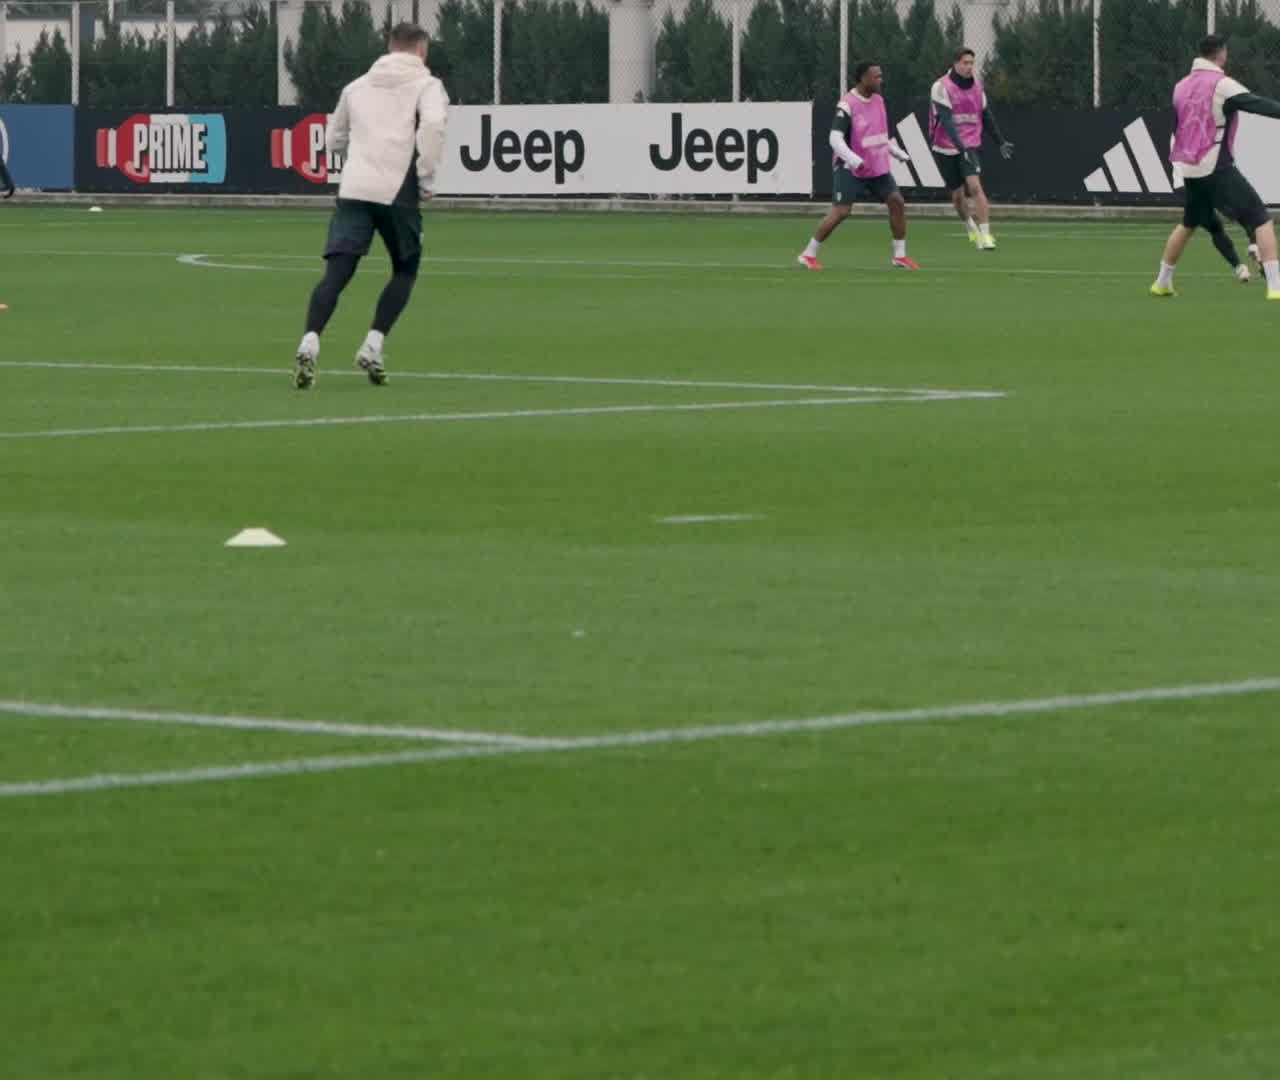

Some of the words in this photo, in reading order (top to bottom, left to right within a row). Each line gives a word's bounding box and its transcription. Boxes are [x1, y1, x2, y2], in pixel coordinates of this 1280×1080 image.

[133, 123, 207, 171] PRIME
[459, 114, 585, 184] Jeep
[649, 112, 779, 184] Jeep
